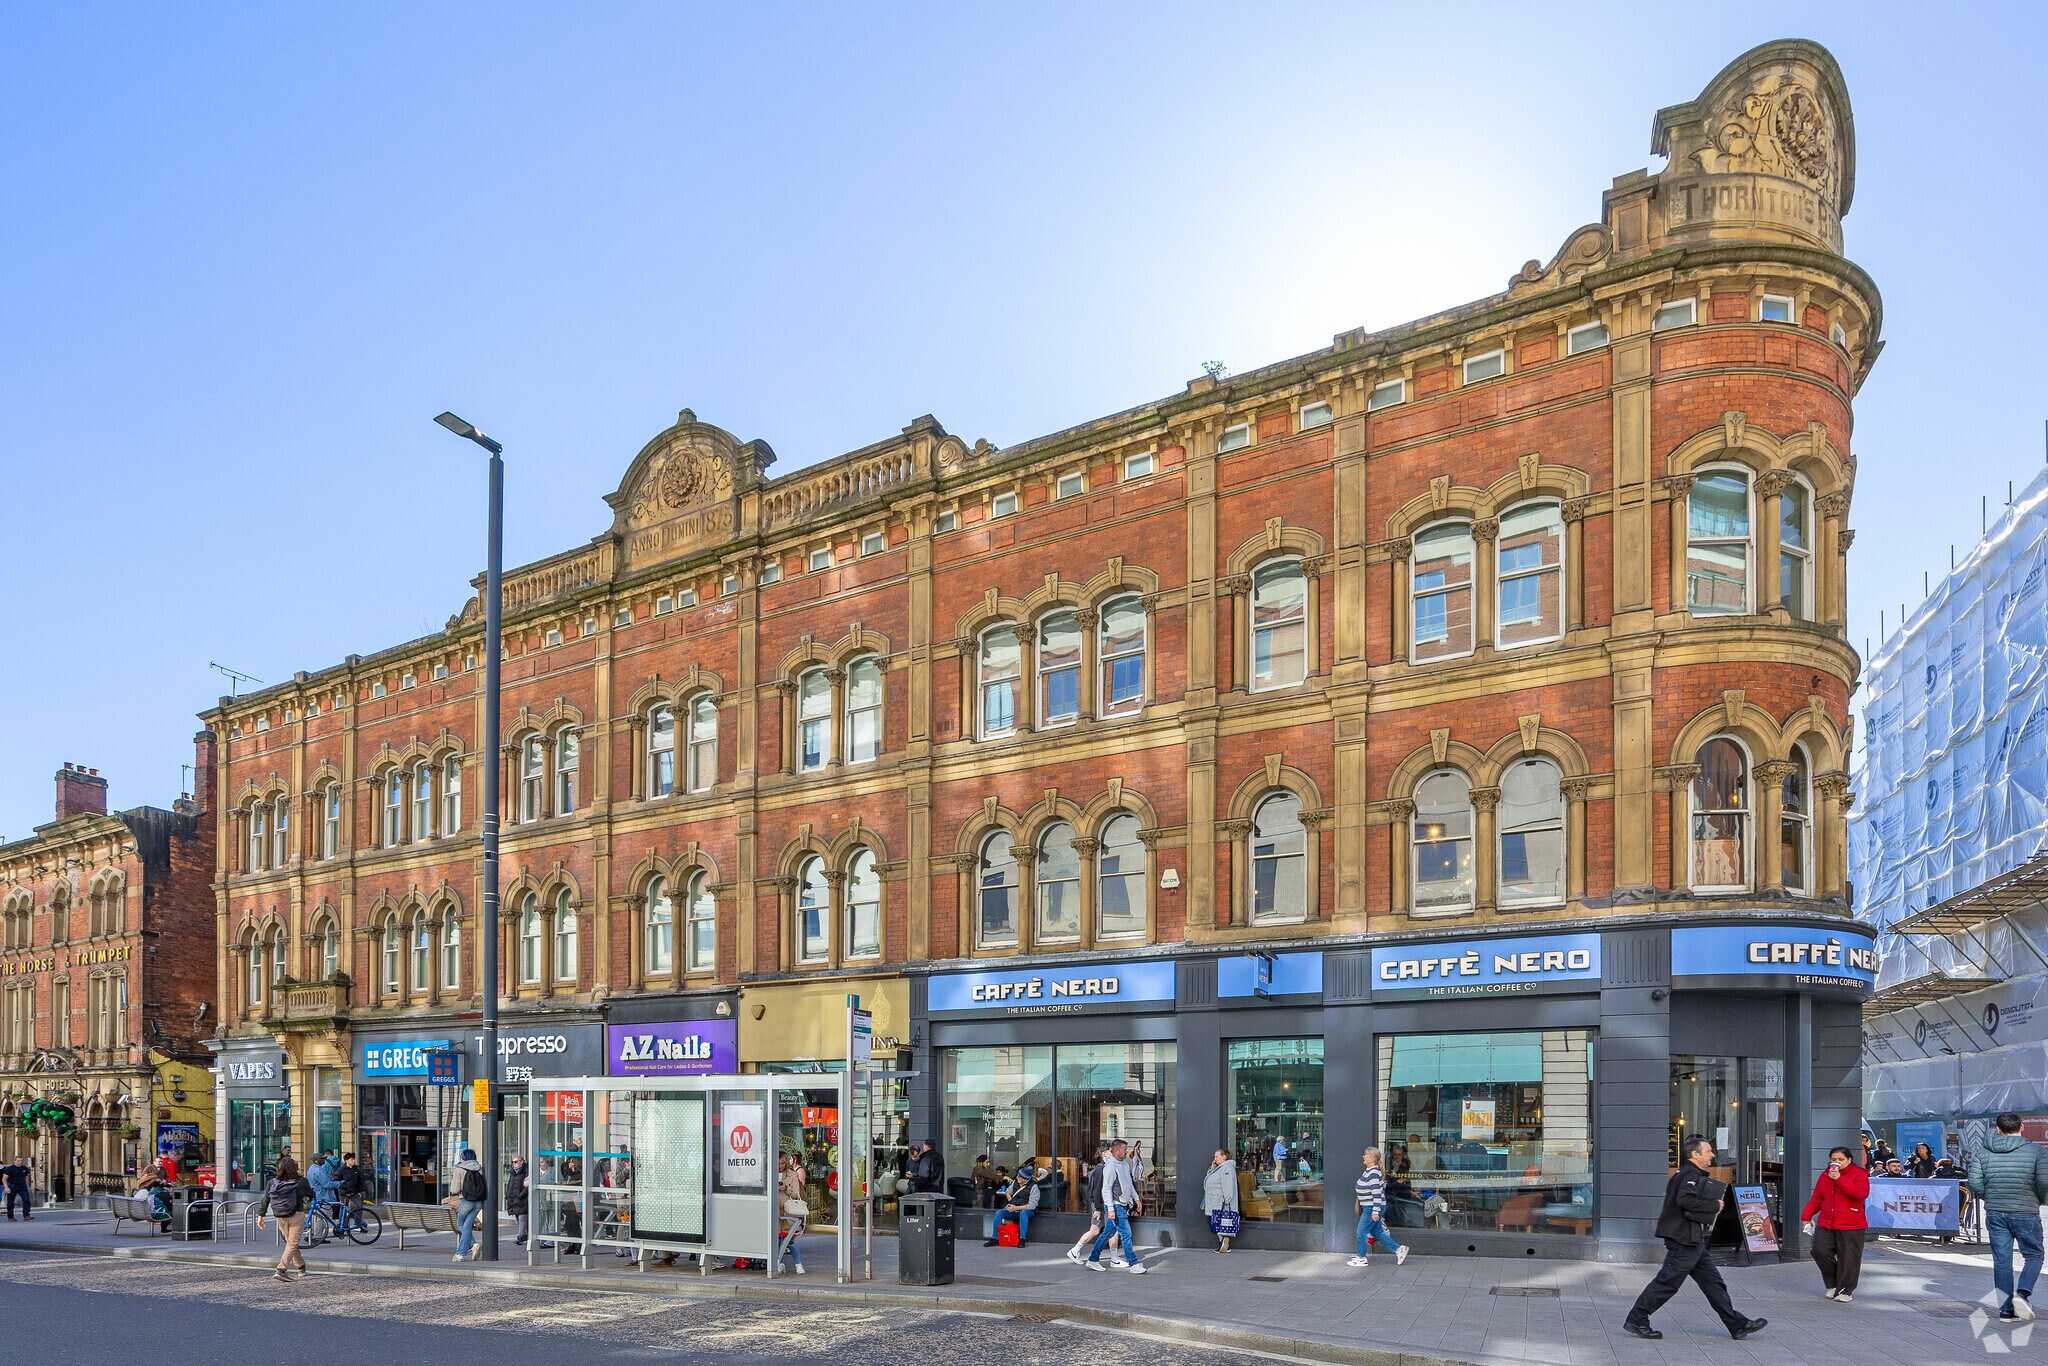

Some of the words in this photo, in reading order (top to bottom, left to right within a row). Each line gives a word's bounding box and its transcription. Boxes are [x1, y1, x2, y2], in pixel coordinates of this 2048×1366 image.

[630, 531, 660, 557] ANNO
[661, 518, 699, 547] DOMINI
[20, 957, 55, 973] HORSE
[75, 946, 132, 966] TRUMPET
[1747, 937, 1841, 966] CAFFÈ
[1845, 947, 1879, 974] NER
[1380, 950, 1480, 981] CAFFÈ
[1494, 949, 1591, 975] NERO
[971, 976, 1042, 1001] CAFFÈ
[1051, 977, 1119, 997] NERO
[1429, 987, 1444, 995] THE
[1447, 986, 1484, 994] ITALIAN
[1486, 984, 1521, 993] COFFEE
[1795, 975, 1810, 984] THE
[1811, 976, 1838, 985] ITALIAN
[1839, 978, 1858, 988] COFFEE
[1007, 1006, 1018, 1014] THE
[1020, 1005, 1046, 1013] ITALIAN
[1048, 1004, 1072, 1012] COFFEE
[475, 1035, 567, 1063] Tapresso
[620, 1035, 656, 1061] AZ
[657, 1035, 714, 1060] Nails
[382, 1046, 443, 1069] GREG
[229, 1062, 274, 1080] VAPES
[46, 1079, 70, 1090] HOTEL
[780, 1093, 798, 1102] Beauty
[1463, 1111, 1493, 1127] BRAZIL
[728, 1158, 756, 1167] METRO
[1899, 1193, 1927, 1201] CAFFÈ
[1883, 1201, 1943, 1214] NERO
